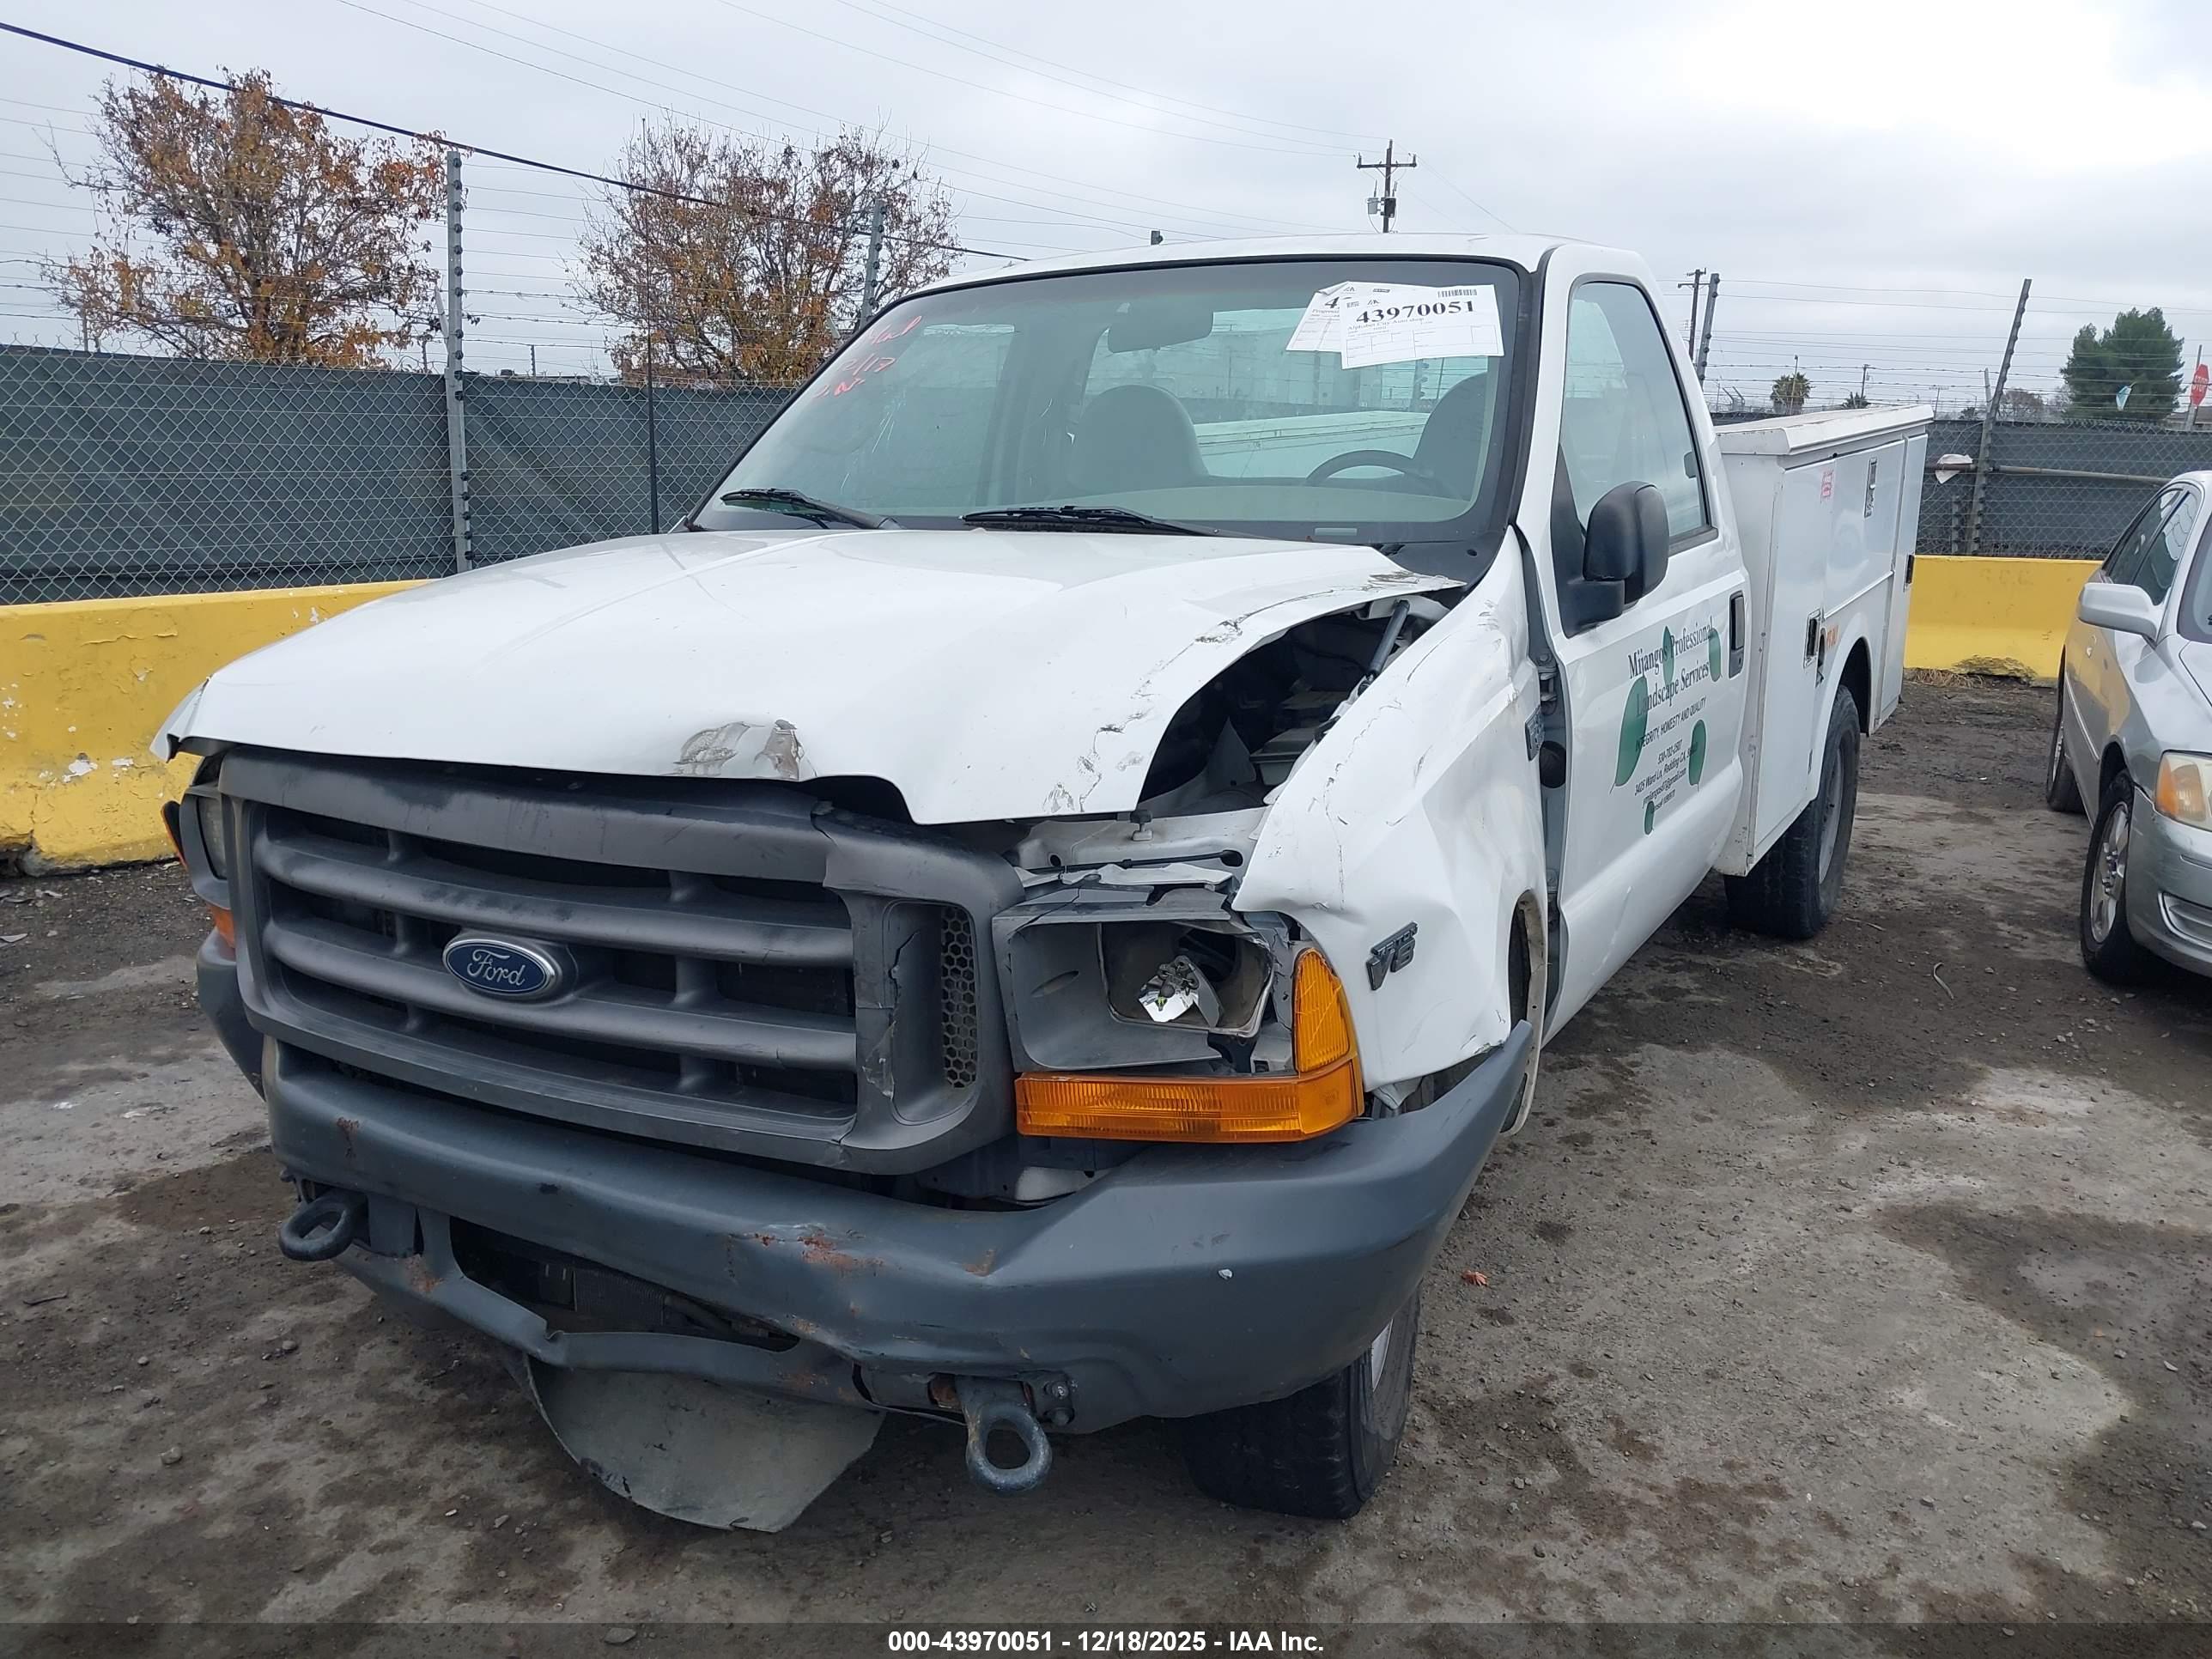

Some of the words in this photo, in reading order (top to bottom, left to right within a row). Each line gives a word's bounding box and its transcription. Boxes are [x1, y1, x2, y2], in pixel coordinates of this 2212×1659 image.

[1356, 301, 1476, 324] 43970051
[2192, 374, 2208, 392] STOP
[1628, 644, 1668, 679] Mijangos
[1668, 615, 1713, 659] Professional
[1636, 682, 1679, 718] Landscape
[1680, 660, 1709, 690] Services
[466, 949, 526, 986] Ford
